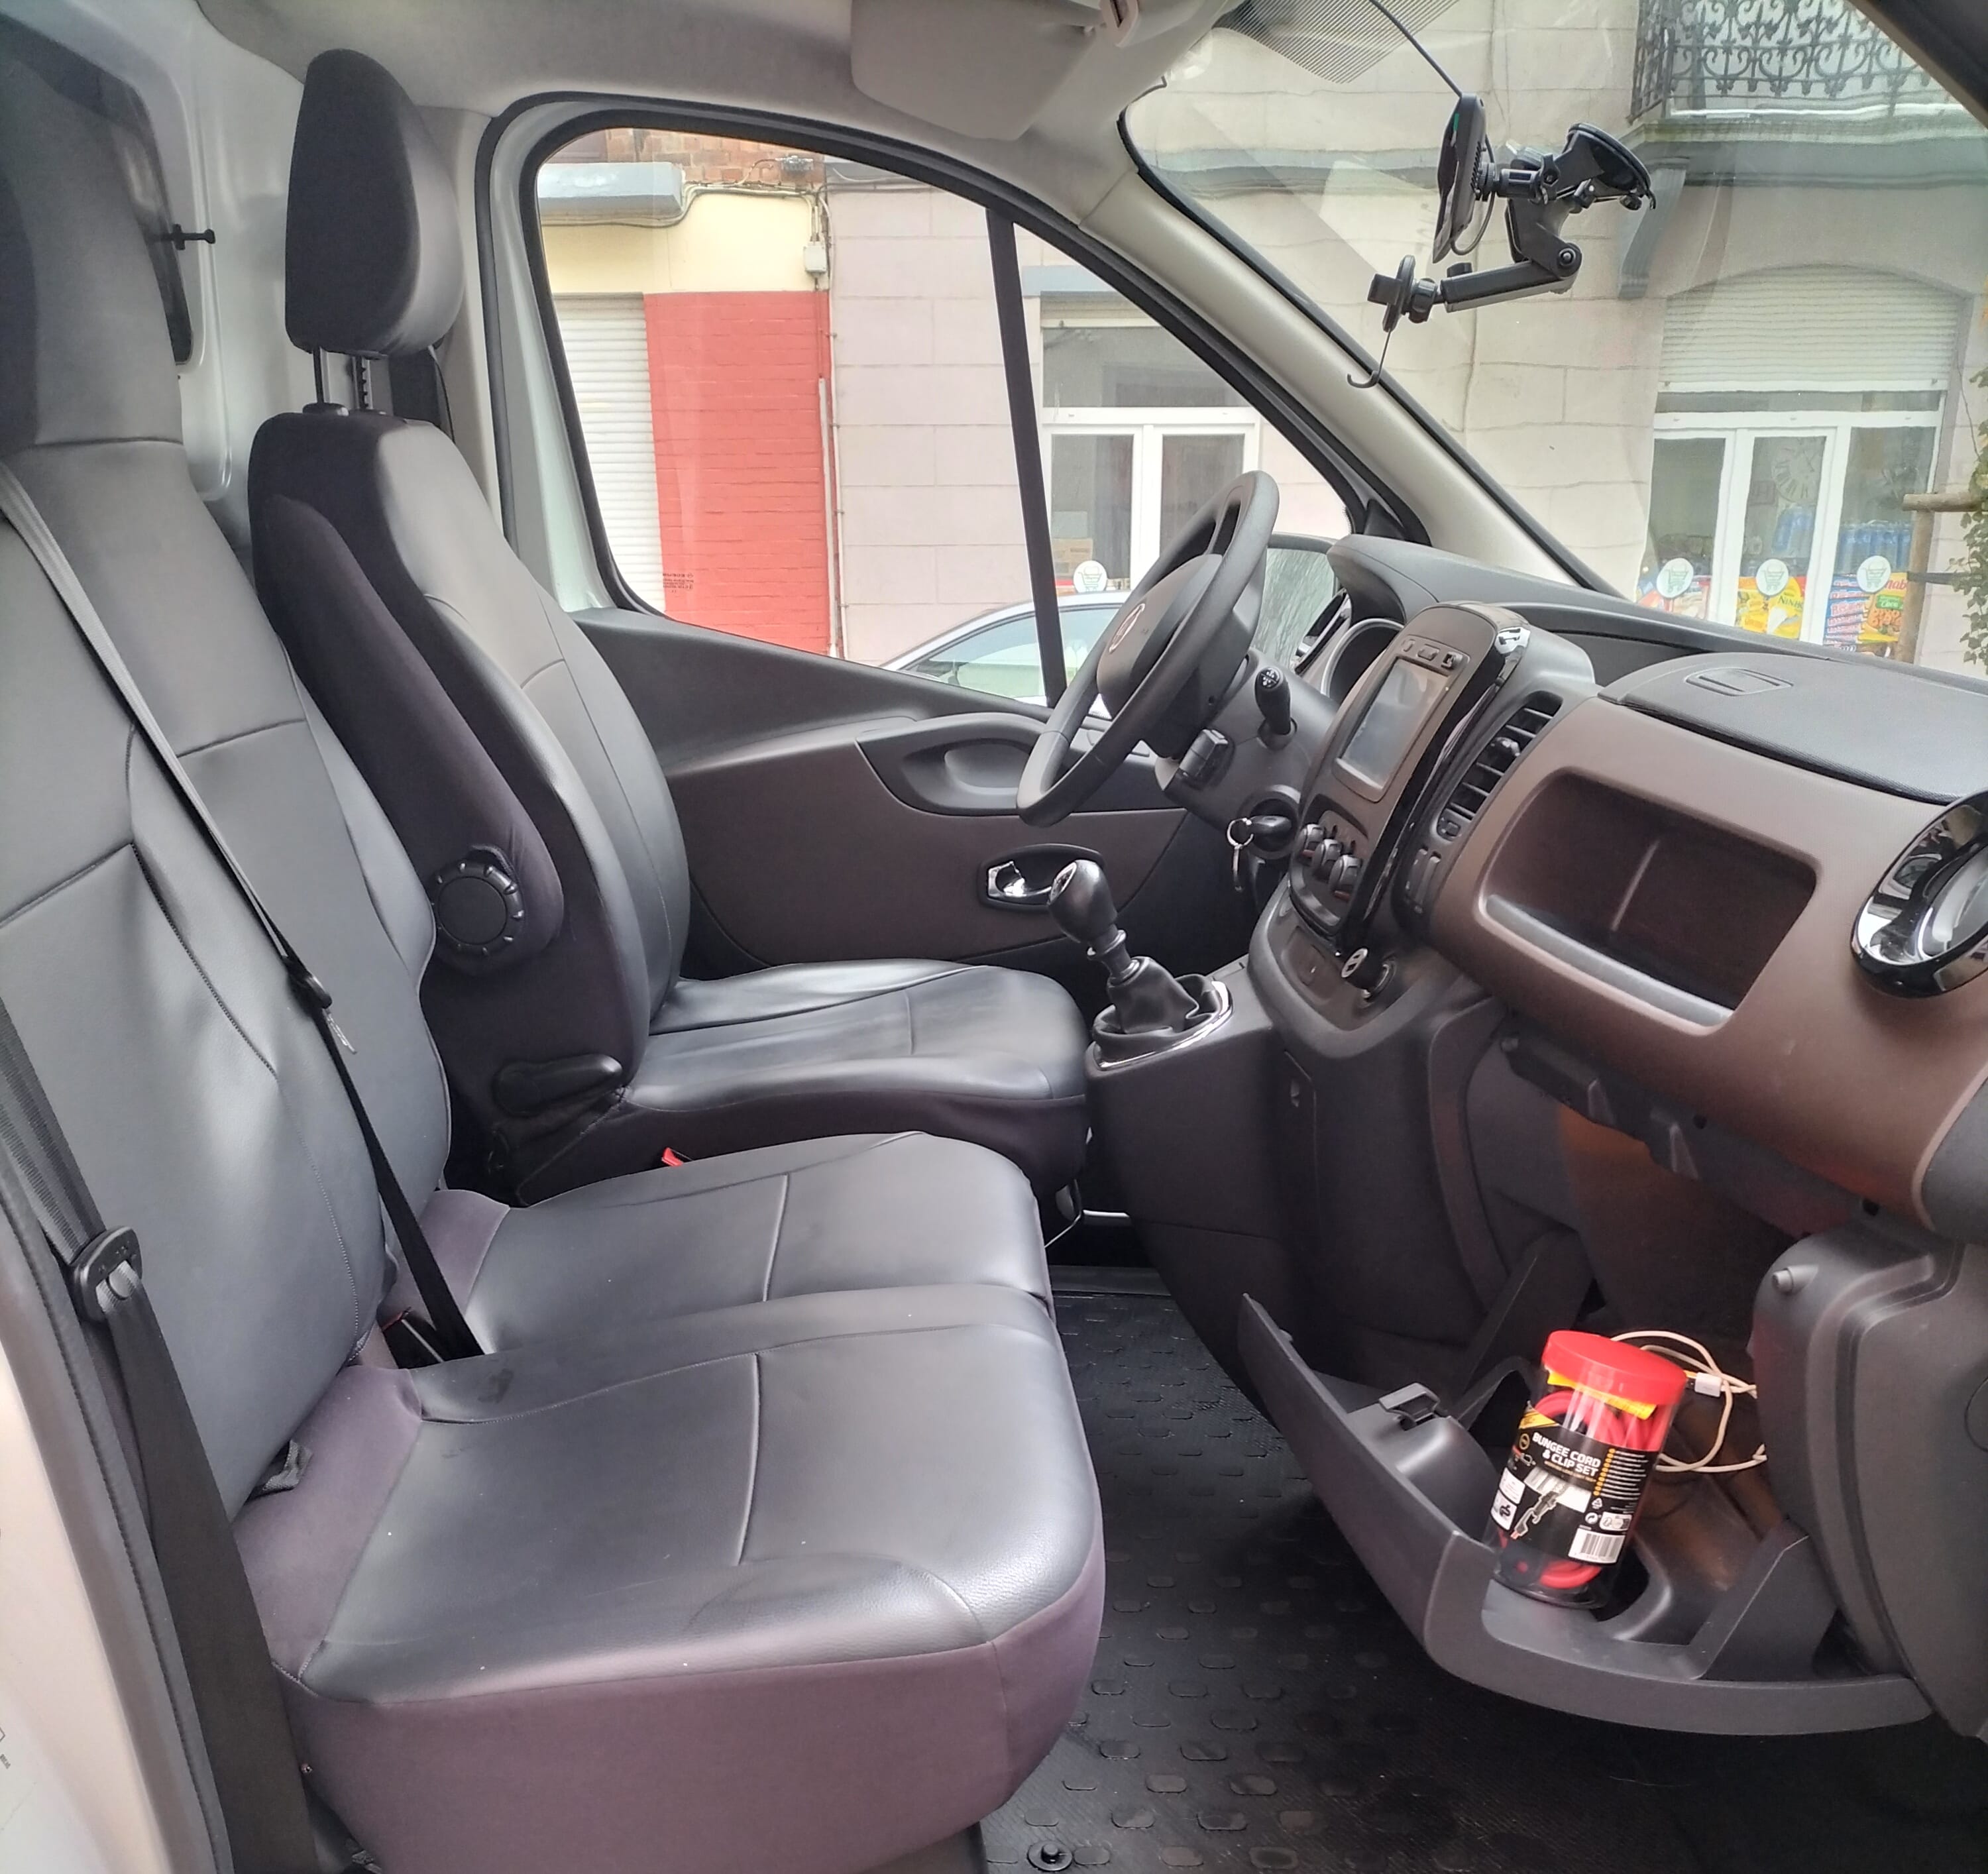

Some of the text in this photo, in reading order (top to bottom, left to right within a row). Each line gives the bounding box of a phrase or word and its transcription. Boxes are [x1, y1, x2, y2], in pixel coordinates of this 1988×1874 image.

[1532, 1432, 1601, 1468] BUNGEE CORD
[1542, 1449, 1551, 1459] &
[1551, 1453, 1575, 1468] CLIP
[1574, 1463, 1599, 1476] SET
